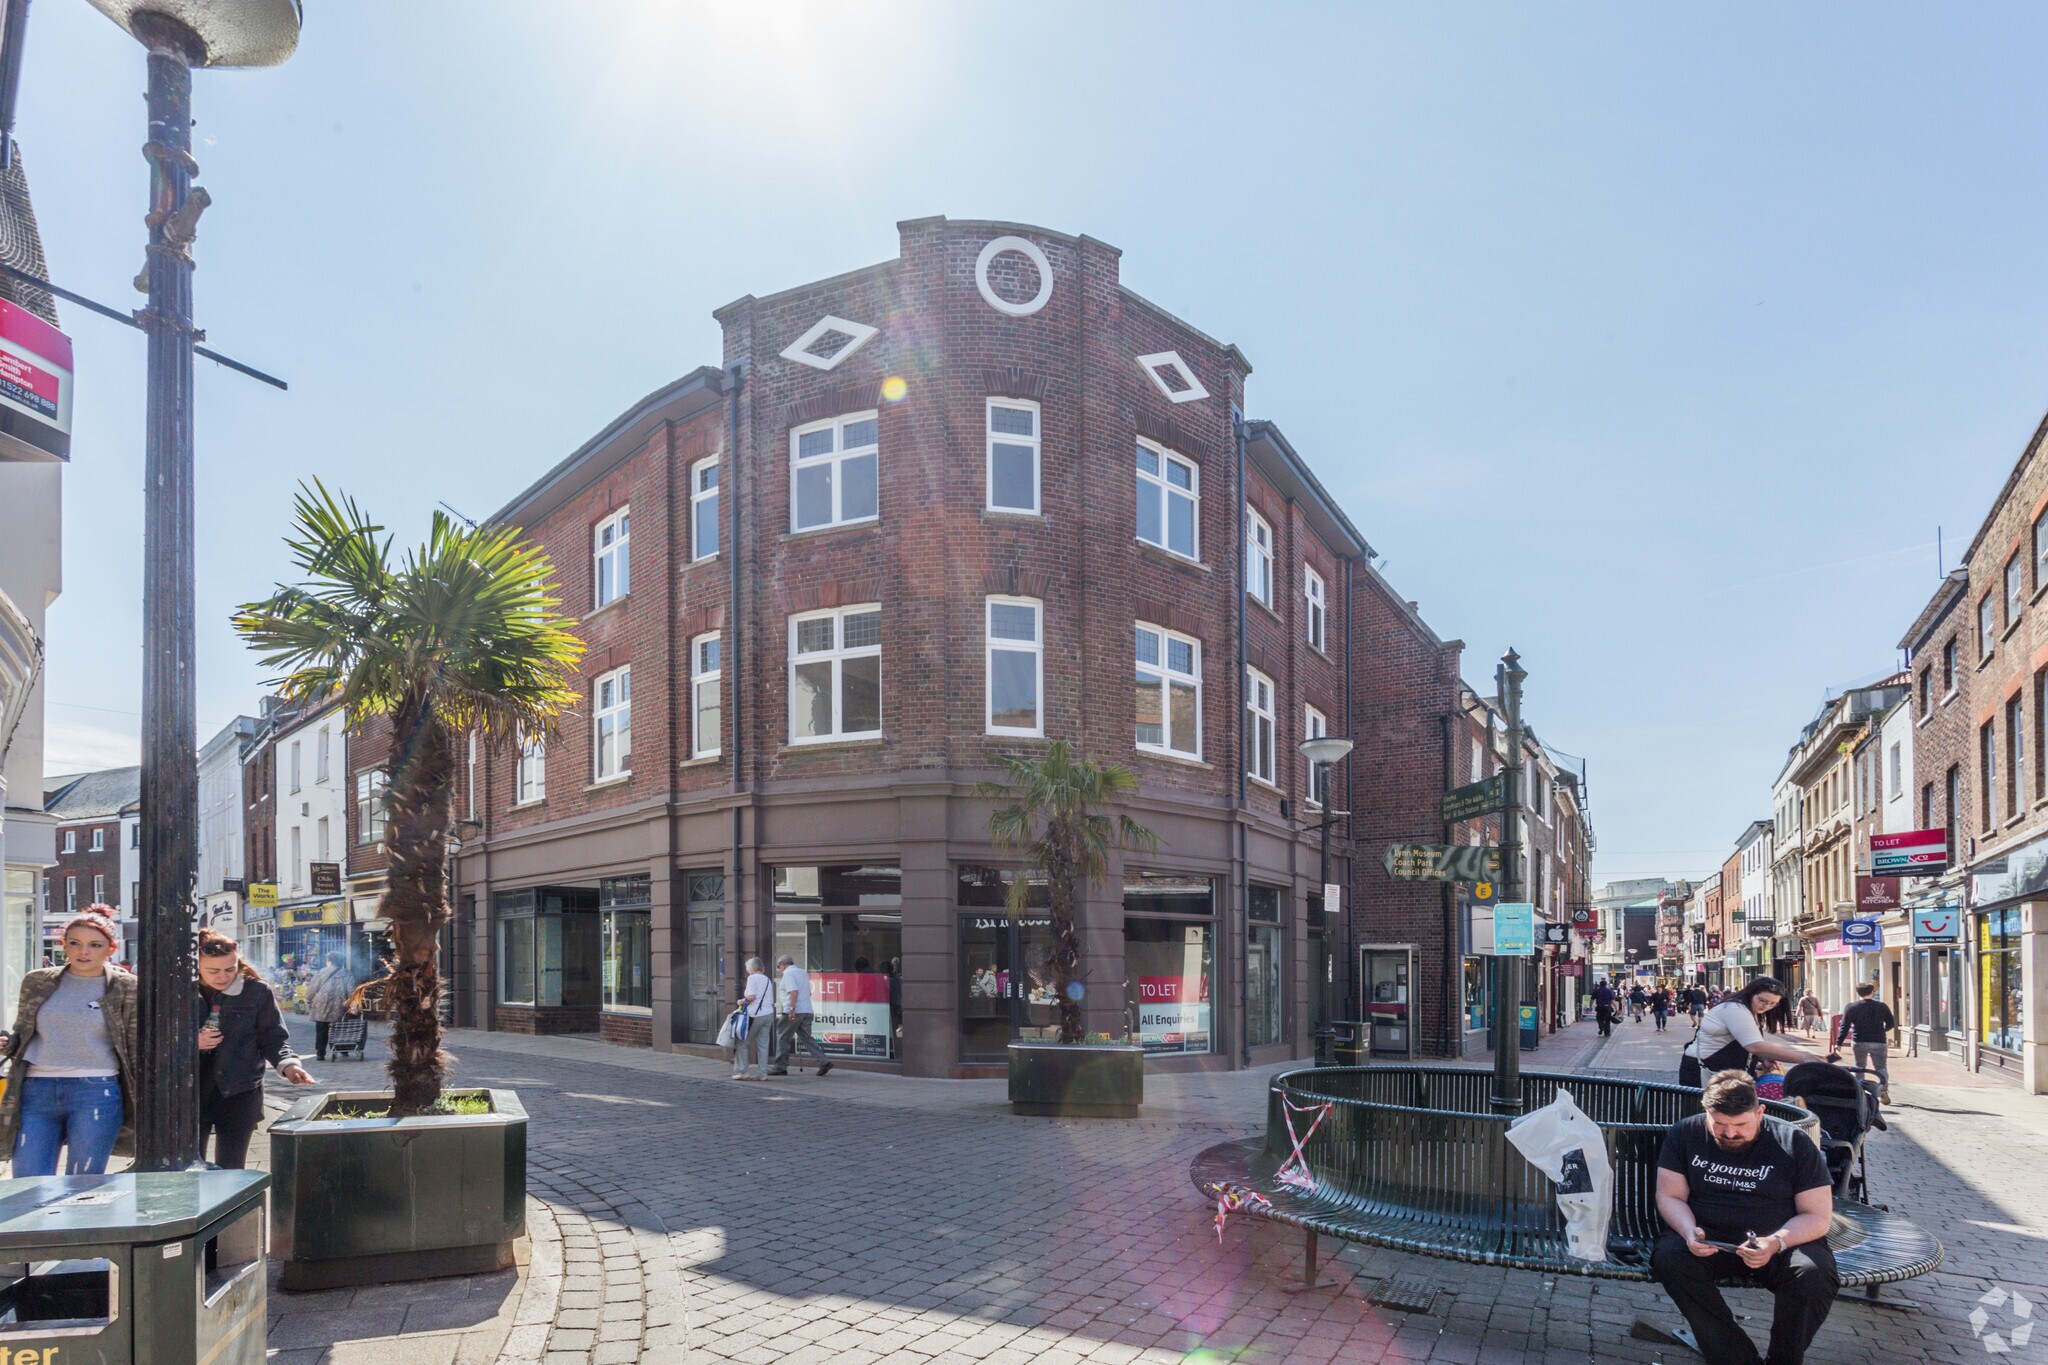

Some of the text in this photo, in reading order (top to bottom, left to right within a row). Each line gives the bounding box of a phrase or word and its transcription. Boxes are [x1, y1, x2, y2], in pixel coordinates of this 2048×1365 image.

[1885, 838, 1900, 846] LET
[1394, 848, 1442, 858] Lynn Museum
[1394, 858, 1433, 867] Coach Park
[1394, 868, 1446, 877] Council Offices
[819, 980, 844, 994] LET
[1140, 983, 1177, 997] TO LET
[814, 1013, 868, 1026] Enquiries
[1141, 1014, 1195, 1027] All Enquiries
[1691, 1154, 1774, 1181] be yourself
[1703, 1174, 1757, 1190] LGBT+ M&S
